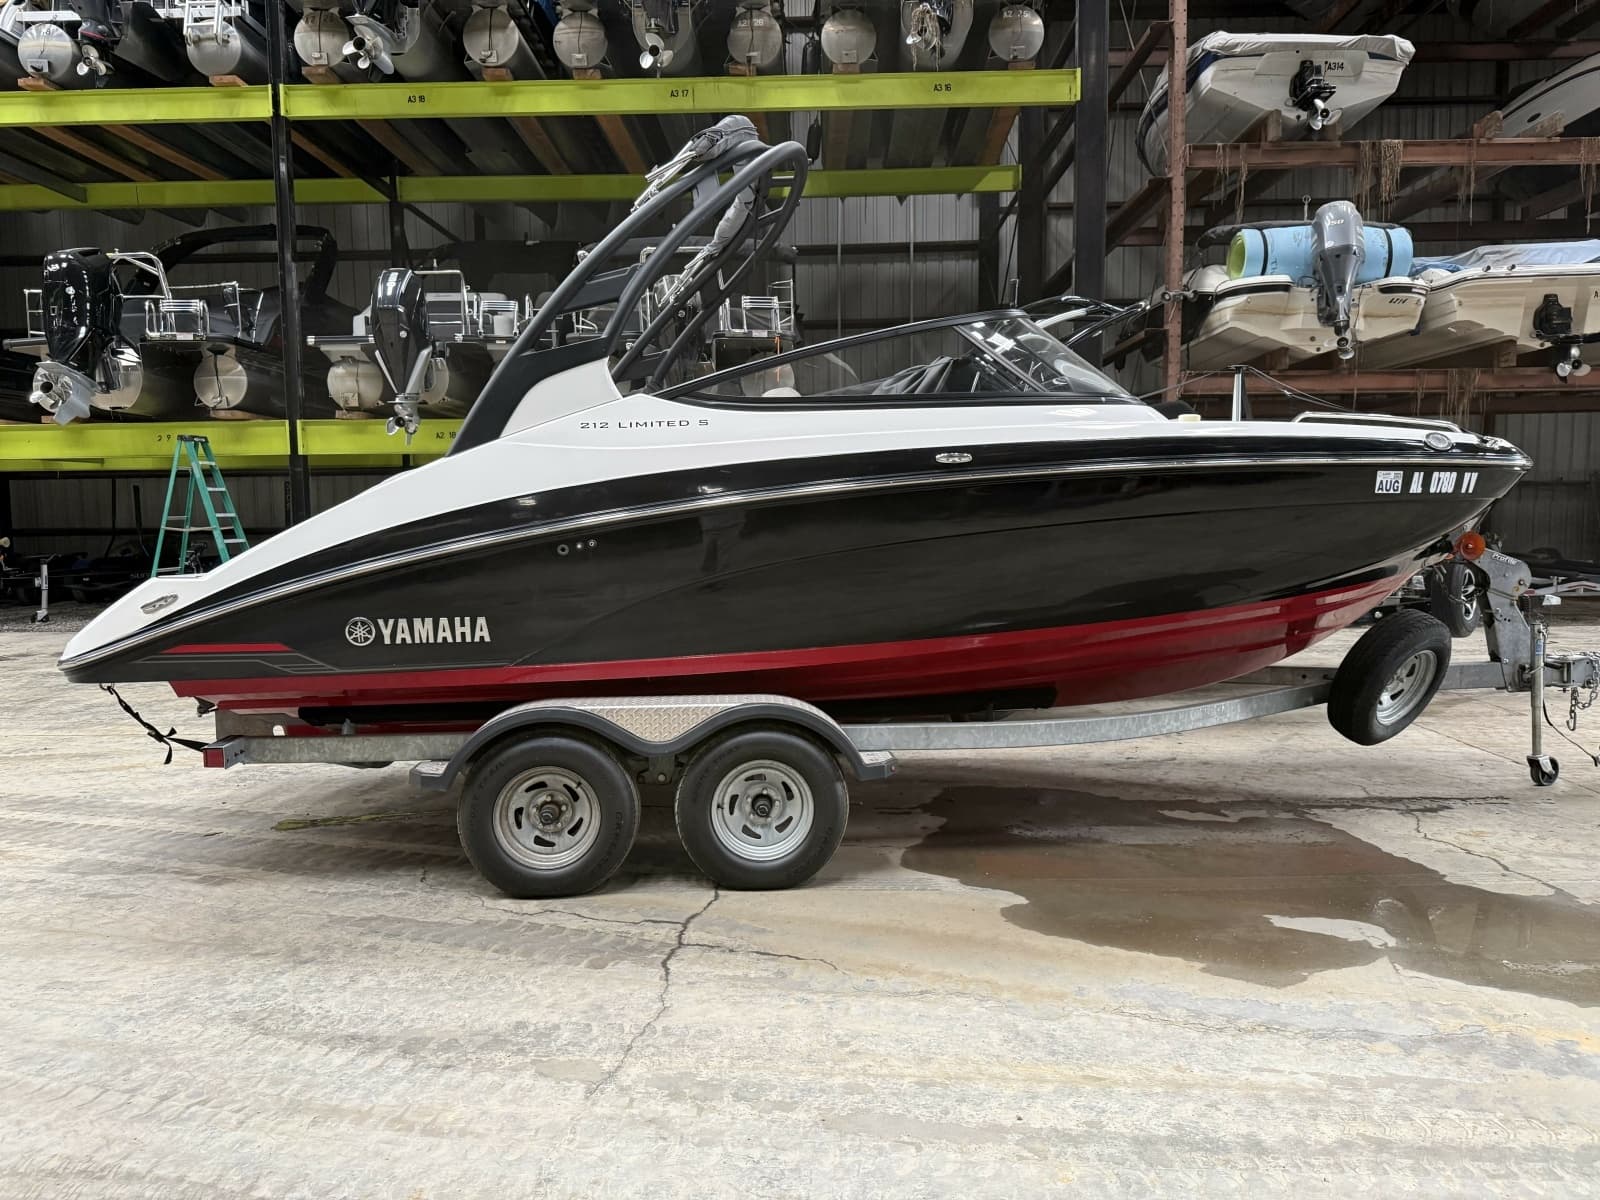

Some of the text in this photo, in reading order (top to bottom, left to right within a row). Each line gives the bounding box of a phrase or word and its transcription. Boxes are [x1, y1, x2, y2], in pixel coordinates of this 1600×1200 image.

[670, 89, 679, 98] A3
[580, 421, 609, 429] 212
[618, 419, 690, 429] LIMITED
[1377, 479, 1400, 492] AUG
[377, 616, 491, 645] YAMAHA
